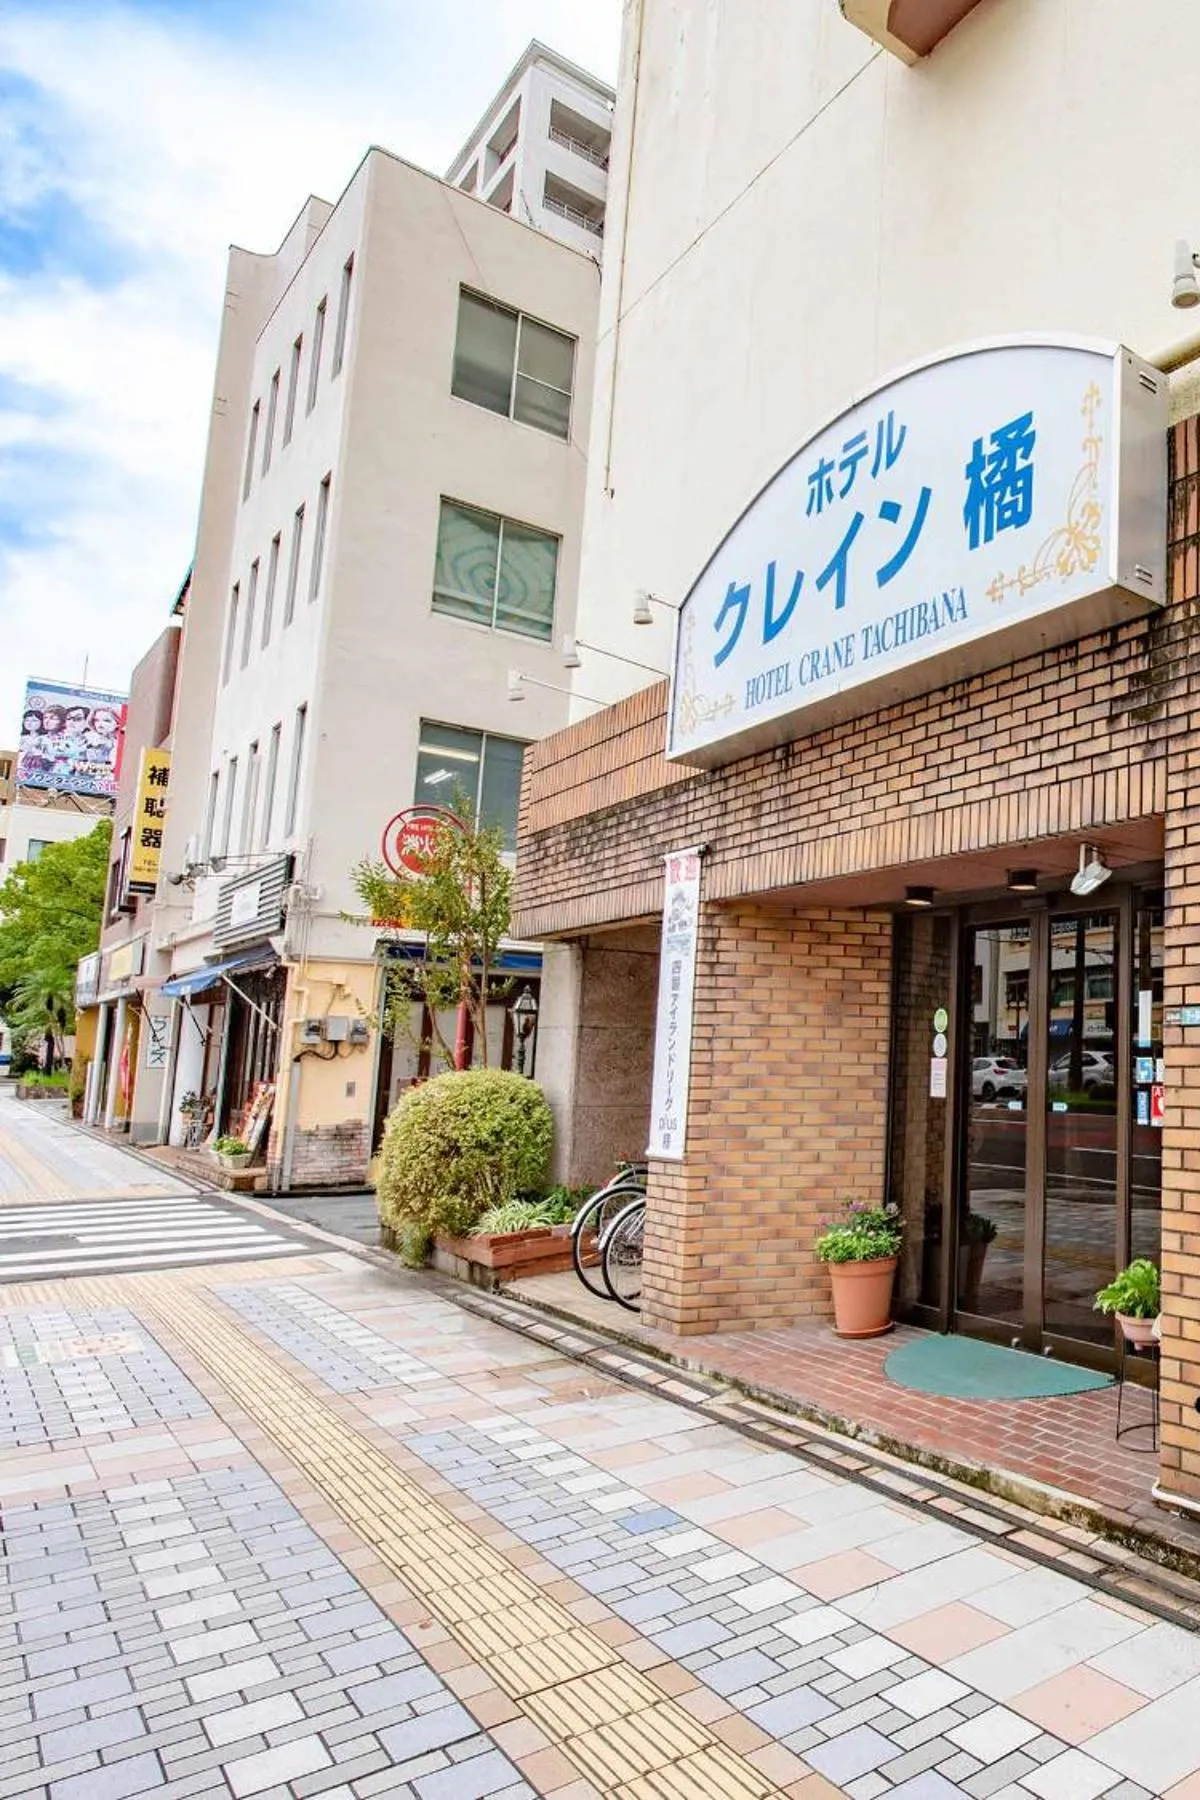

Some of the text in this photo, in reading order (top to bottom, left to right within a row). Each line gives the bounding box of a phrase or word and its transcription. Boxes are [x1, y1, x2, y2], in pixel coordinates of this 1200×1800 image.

[806, 410, 907, 518] ホテル
[713, 411, 1036, 669] クレイン 橘
[744, 587, 968, 710] HOTEL CRANE TACHIBANA
[141, 764, 170, 849] 補聴器
